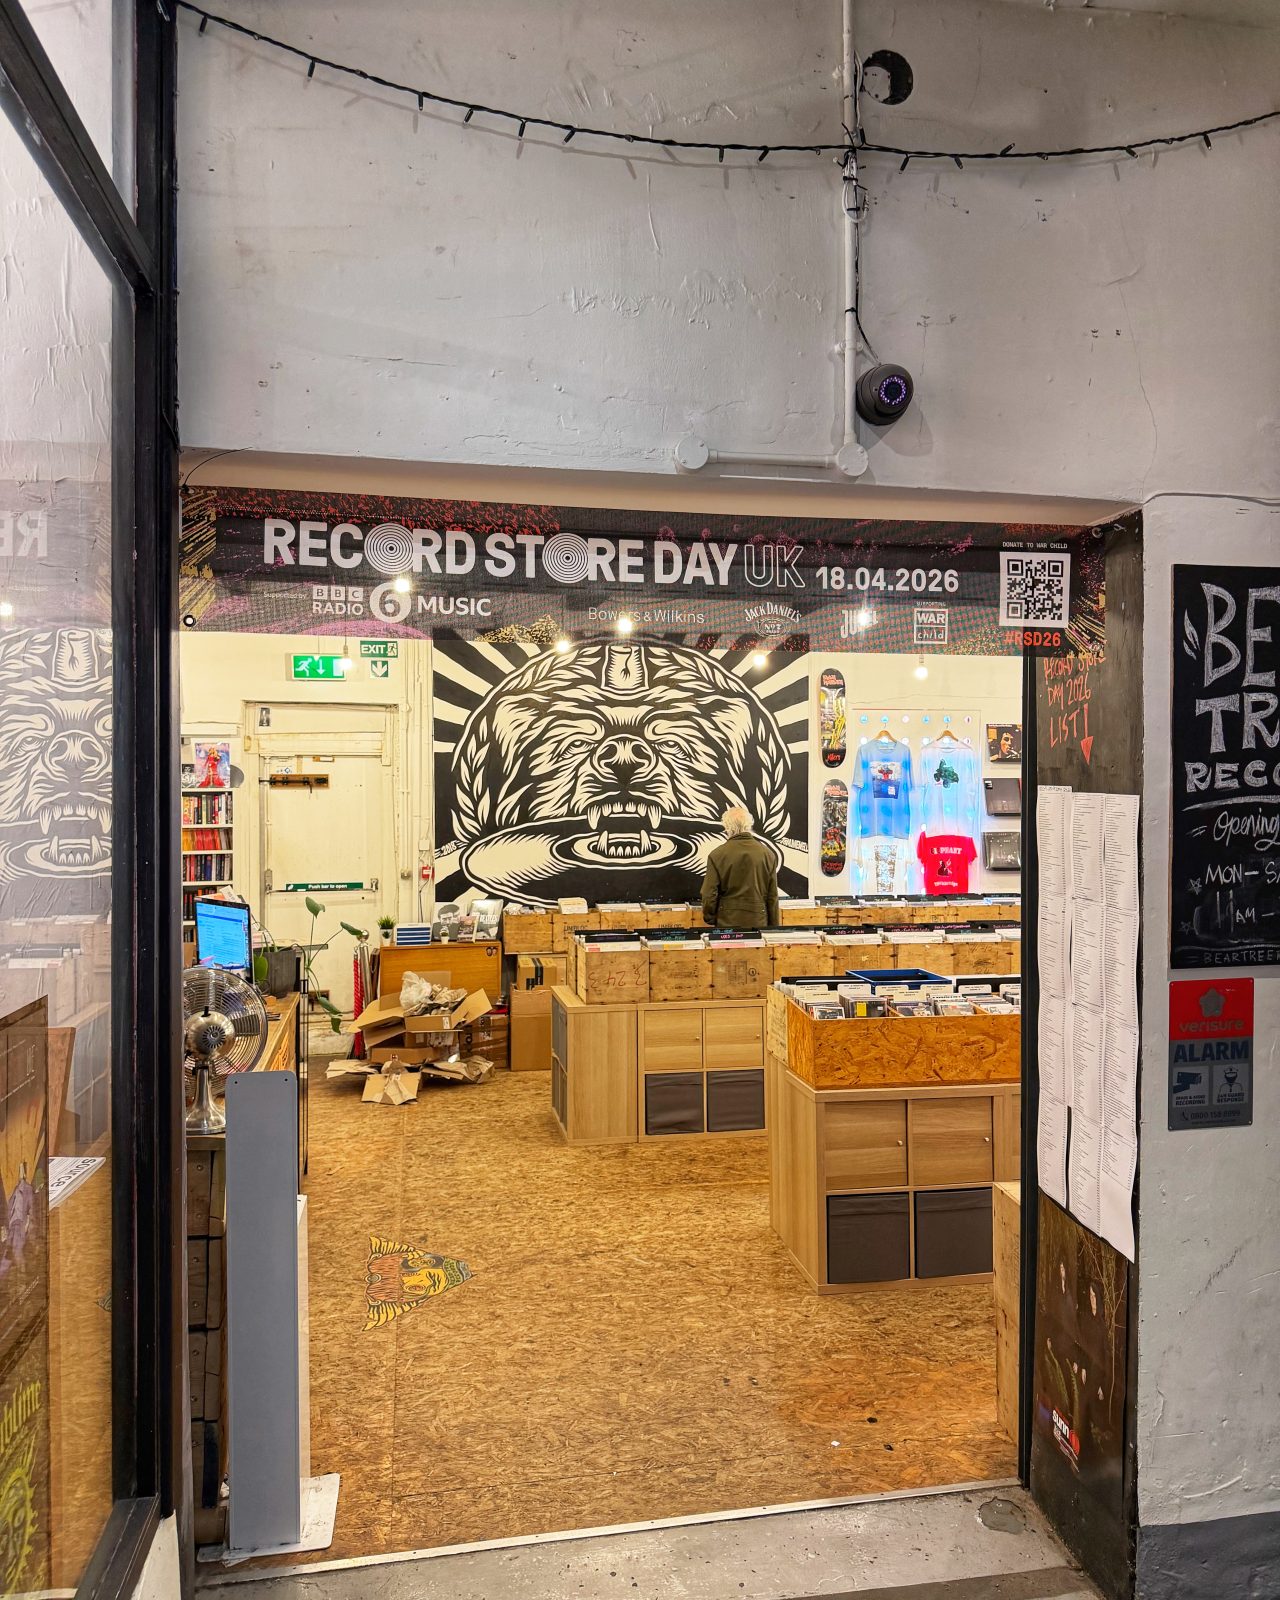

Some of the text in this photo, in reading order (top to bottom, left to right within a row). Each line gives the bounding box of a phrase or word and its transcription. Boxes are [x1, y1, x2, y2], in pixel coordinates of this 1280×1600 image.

[263, 518, 806, 587] RECORD STORE DAY UK
[815, 566, 960, 594] 18.04.2026
[312, 602, 364, 616] RADIO
[417, 595, 492, 617] MUSIC
[643, 611, 651, 622] &
[653, 609, 705, 624] Wilkins
[744, 601, 802, 623] JACK DANIEL'S
[917, 612, 945, 624] WAR
[918, 629, 944, 640] child
[1003, 630, 1061, 647] #RSD26
[361, 644, 387, 654] EXIT
[1048, 673, 1091, 710] DAY 2026
[1050, 708, 1080, 748] LIST
[1184, 760, 1280, 793] REC
[1205, 863, 1243, 885] MON
[1178, 1019, 1245, 1033] verisure
[1173, 1039, 1249, 1064] ALARM
[1052, 1409, 1070, 1440] sunn
